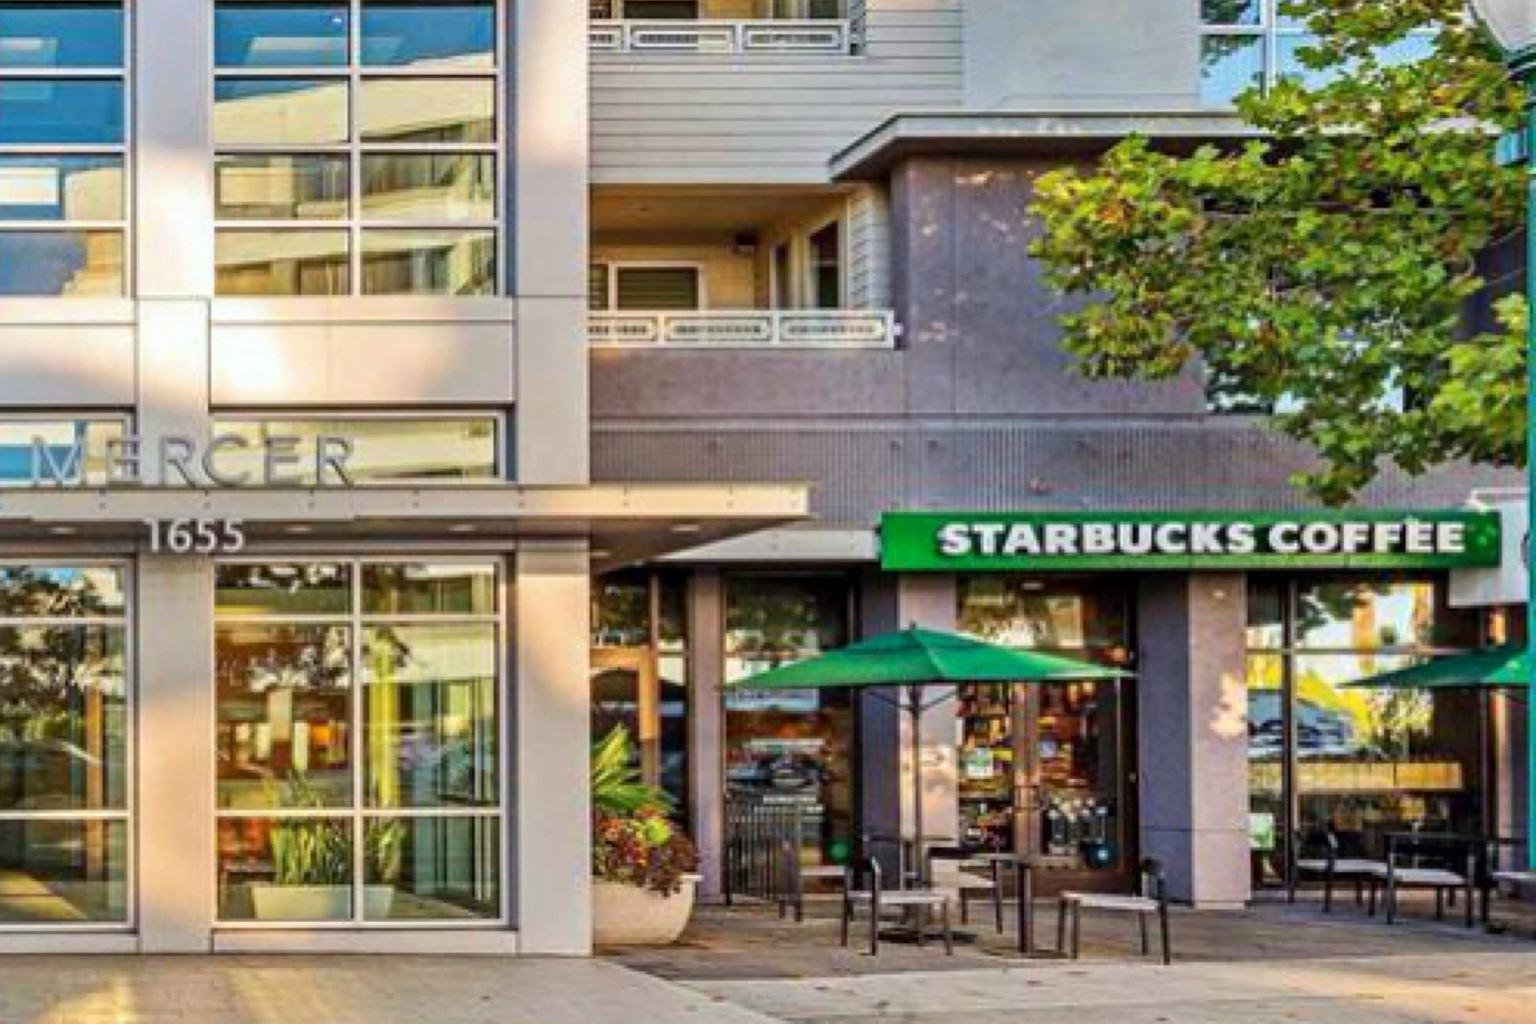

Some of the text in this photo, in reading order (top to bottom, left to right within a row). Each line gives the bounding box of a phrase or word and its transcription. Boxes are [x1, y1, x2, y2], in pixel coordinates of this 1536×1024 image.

[30, 433, 354, 488] MERCER
[144, 518, 245, 554] 1655
[938, 520, 1466, 556] STARBUCKS COFFEE
